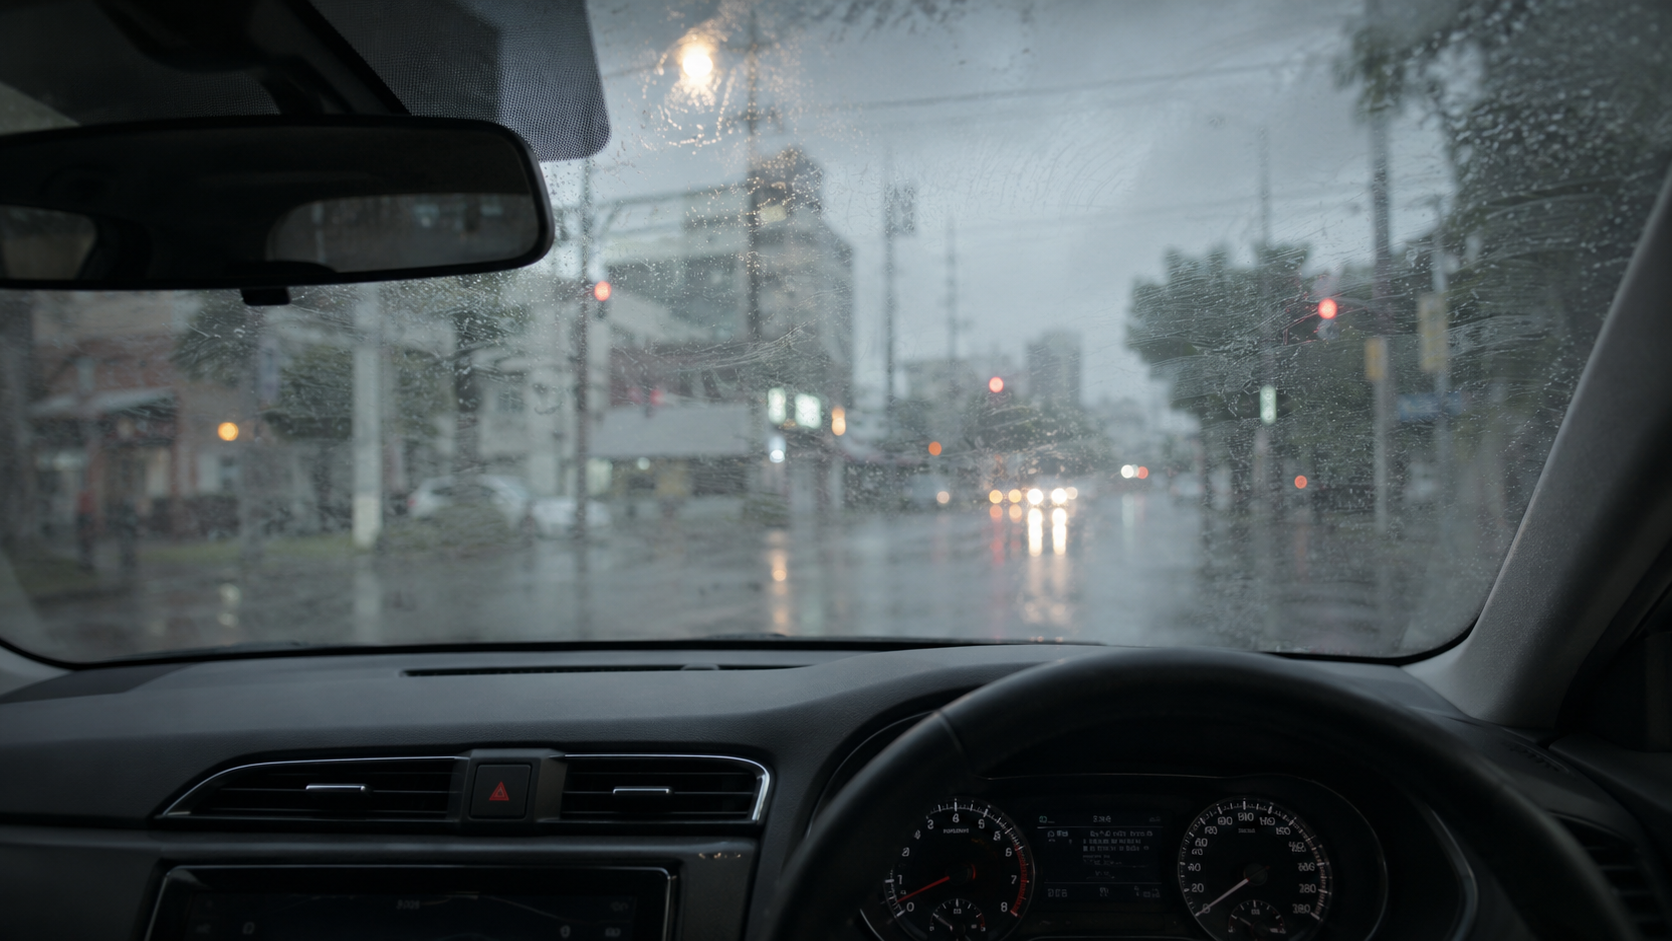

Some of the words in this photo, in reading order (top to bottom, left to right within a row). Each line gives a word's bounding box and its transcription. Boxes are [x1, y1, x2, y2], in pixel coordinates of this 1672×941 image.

[1010, 875, 1017, 885] 7
[1191, 883, 1205, 893] 20
[906, 902, 914, 912] 0
[1000, 902, 1008, 912] 8
